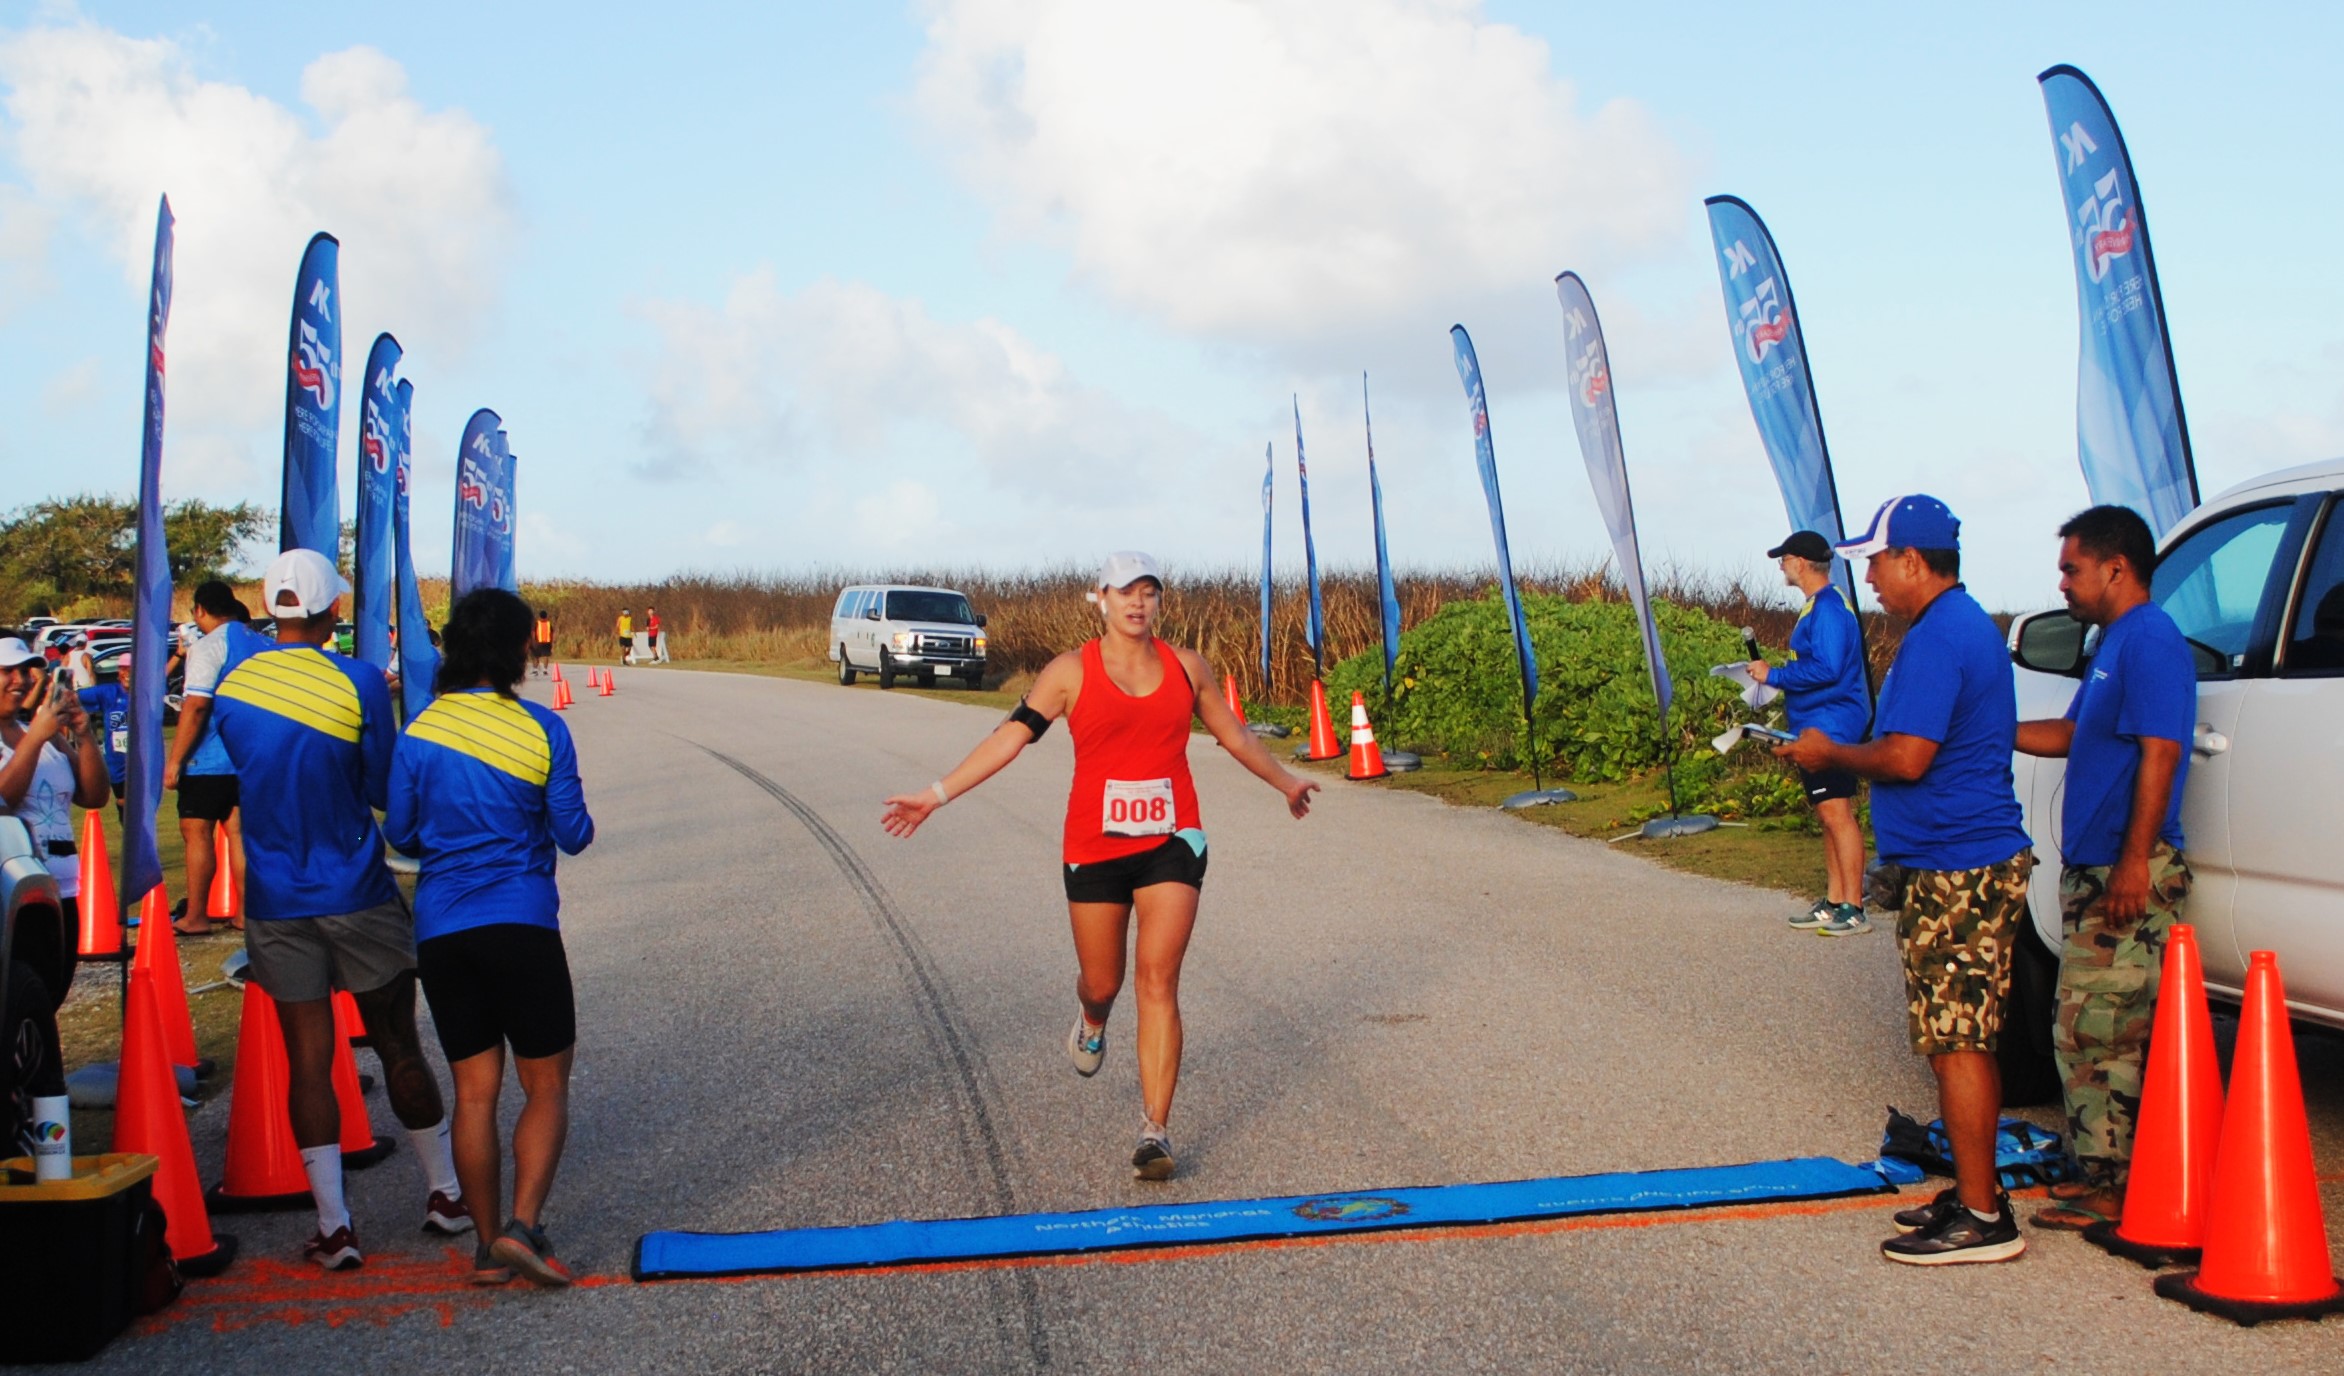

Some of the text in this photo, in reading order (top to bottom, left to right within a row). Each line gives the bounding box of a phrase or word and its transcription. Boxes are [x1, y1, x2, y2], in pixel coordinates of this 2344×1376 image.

[1110, 796, 1166, 824] 008
[1034, 1208, 1272, 1232] Northern Marianas
